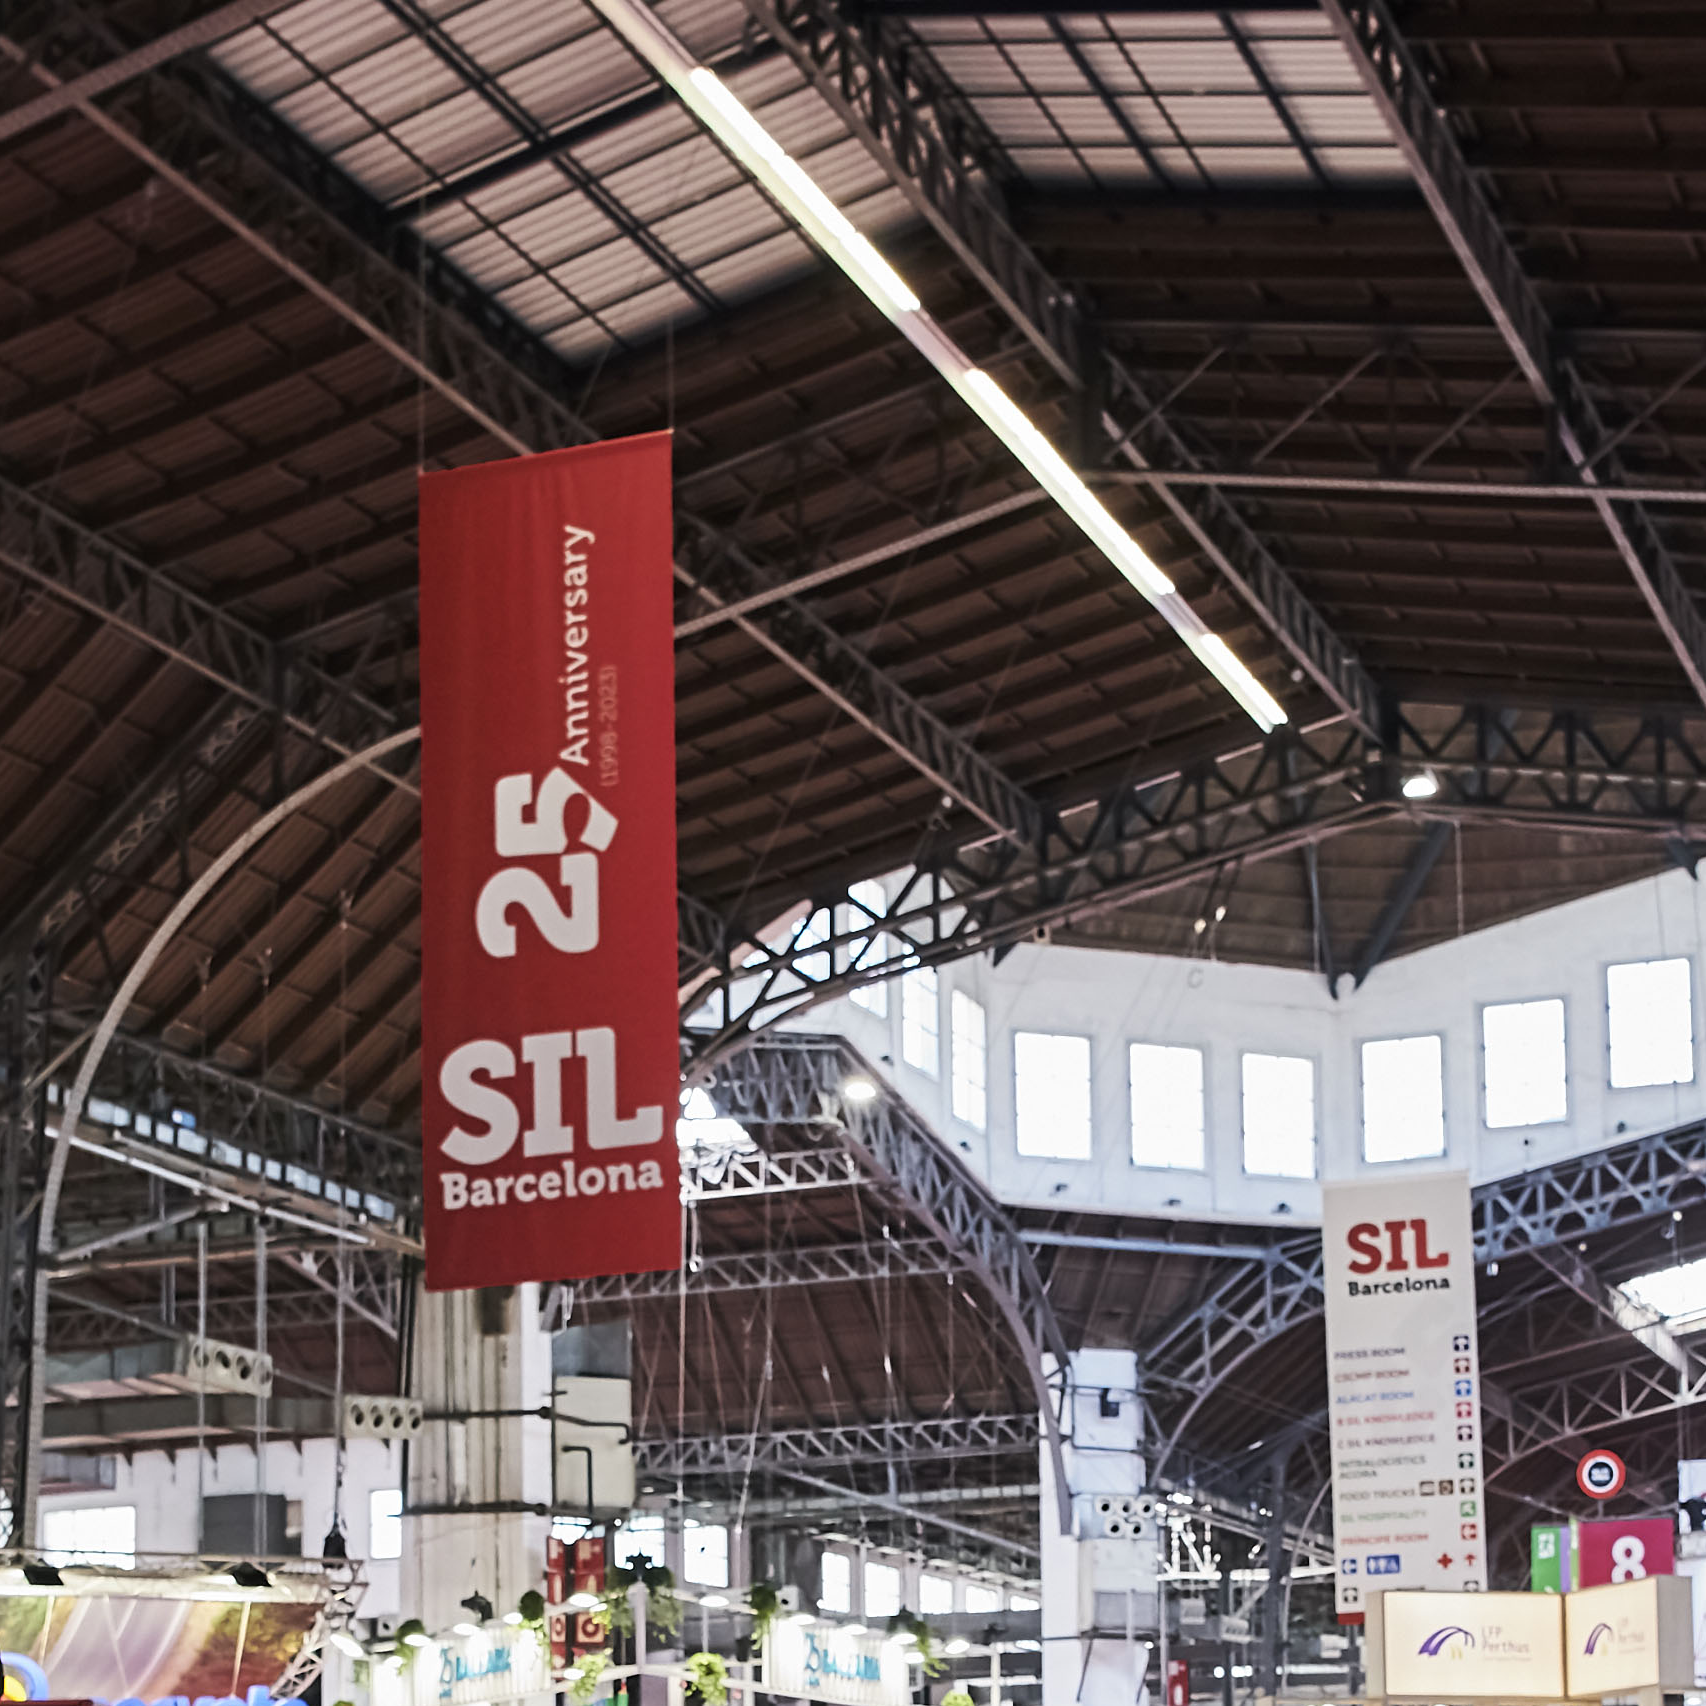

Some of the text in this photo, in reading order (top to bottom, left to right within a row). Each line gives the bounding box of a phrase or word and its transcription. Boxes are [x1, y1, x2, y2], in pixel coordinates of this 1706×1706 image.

[558, 524, 596, 767] Anniversary
[475, 767, 620, 958] 25
[439, 1026, 664, 1165] SIL
[440, 1159, 664, 1211] Barcelona
[1347, 1217, 1450, 1275] SIL
[1348, 1277, 1451, 1297] Barcelona
[1611, 1535, 1647, 1584] 8
